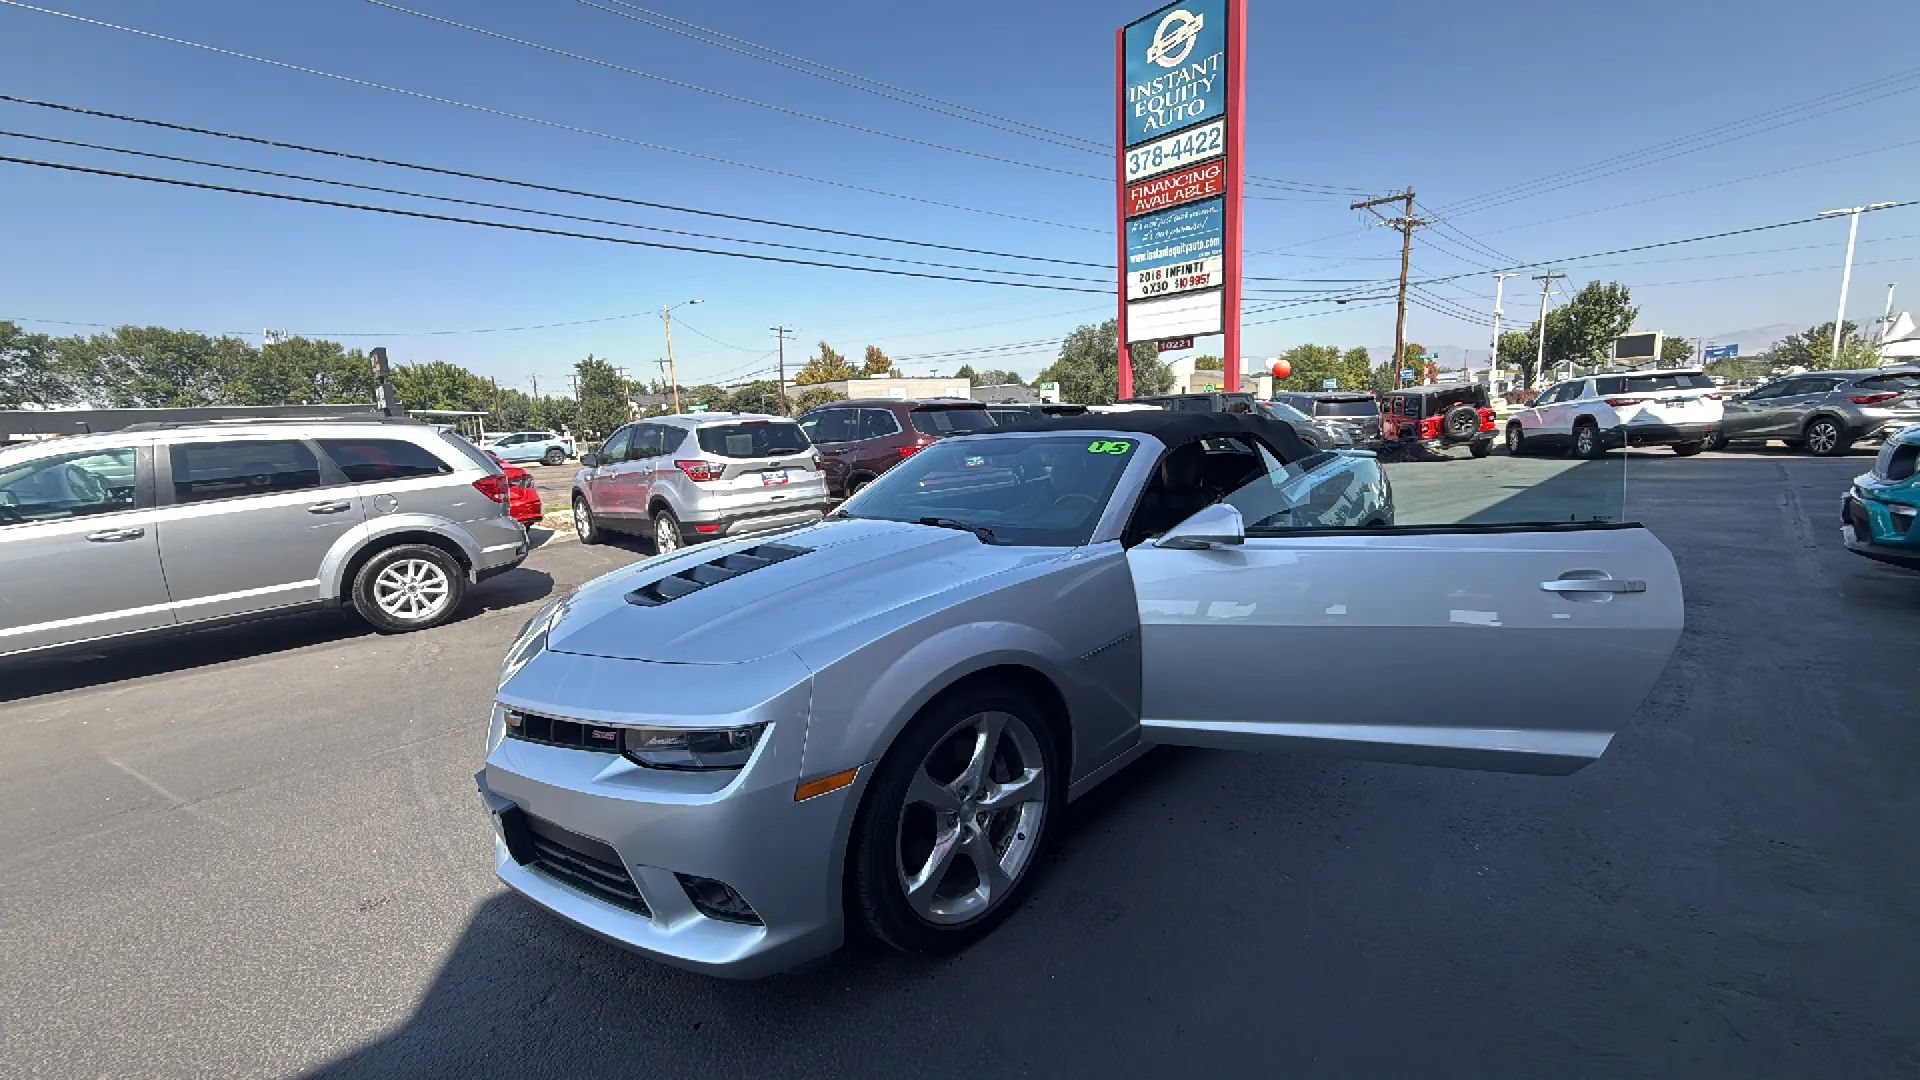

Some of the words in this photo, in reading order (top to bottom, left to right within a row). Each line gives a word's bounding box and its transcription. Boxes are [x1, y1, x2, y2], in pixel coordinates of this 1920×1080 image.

[1129, 52, 1222, 102] INSTANT
[1135, 74, 1216, 117] EQUITY
[1143, 99, 1205, 132] AUTO
[1129, 127, 1221, 174] 378-4422
[1131, 165, 1220, 200] FINANCING
[1135, 180, 1216, 211] AVAILABLE
[1139, 270, 1162, 282] 2018
[1160, 340, 1191, 349] 10221
